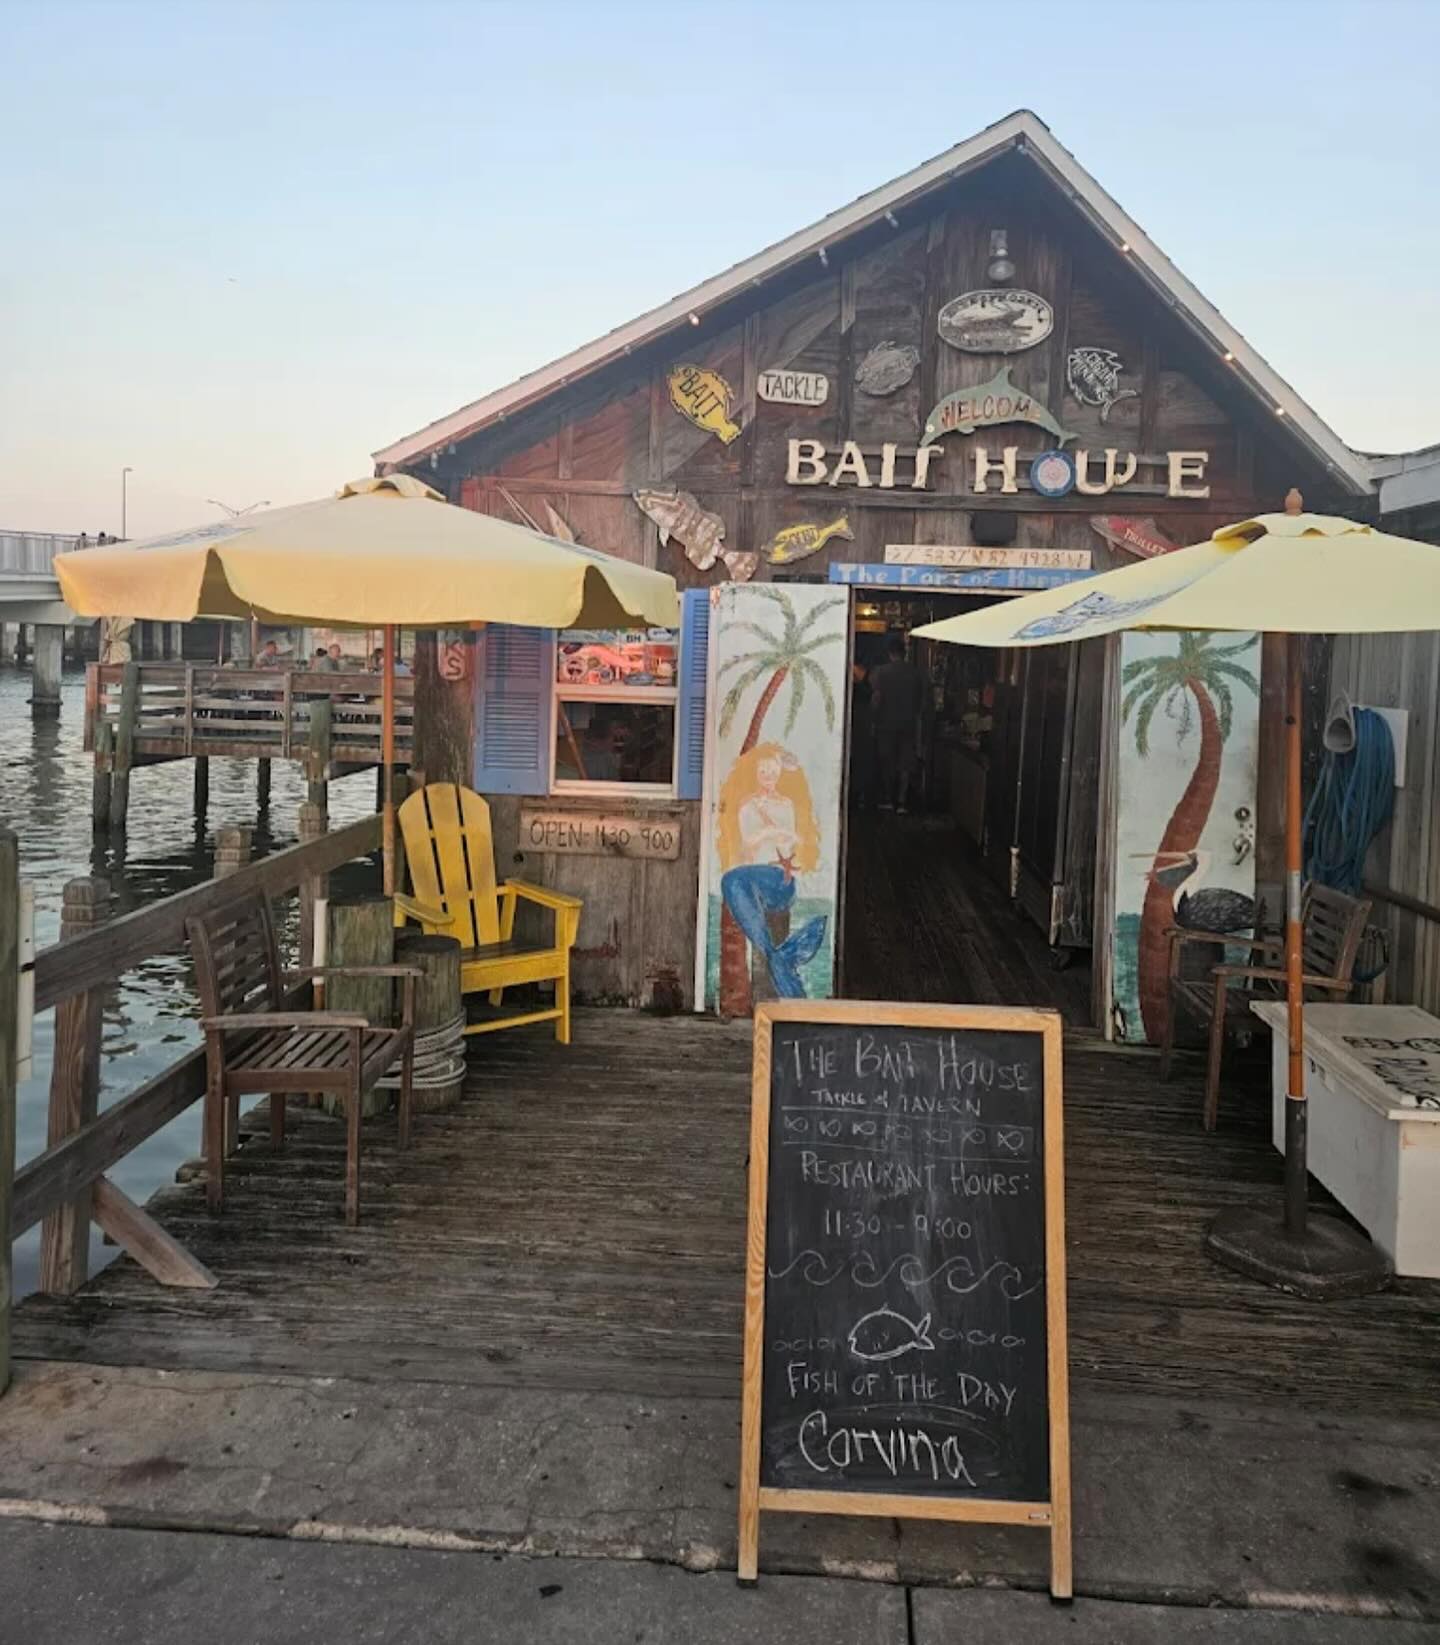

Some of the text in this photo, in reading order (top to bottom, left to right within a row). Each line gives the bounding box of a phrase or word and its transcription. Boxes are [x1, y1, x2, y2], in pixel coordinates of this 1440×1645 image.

[679, 371, 724, 418] BAIT
[763, 374, 824, 400] TACKLE
[784, 438, 944, 489] BAIT
[838, 563, 888, 583] The
[782, 1034, 1032, 1091] THE BAIT HOUSE
[900, 1096, 982, 1117] TAVERN
[801, 1150, 1030, 1197] RESTAURANT HOURS:
[825, 1208, 882, 1237] 11:30
[913, 1213, 973, 1241] 9:00
[787, 1360, 1017, 1416] FISH OF THE DAY
[800, 1409, 977, 1487] Corvina
